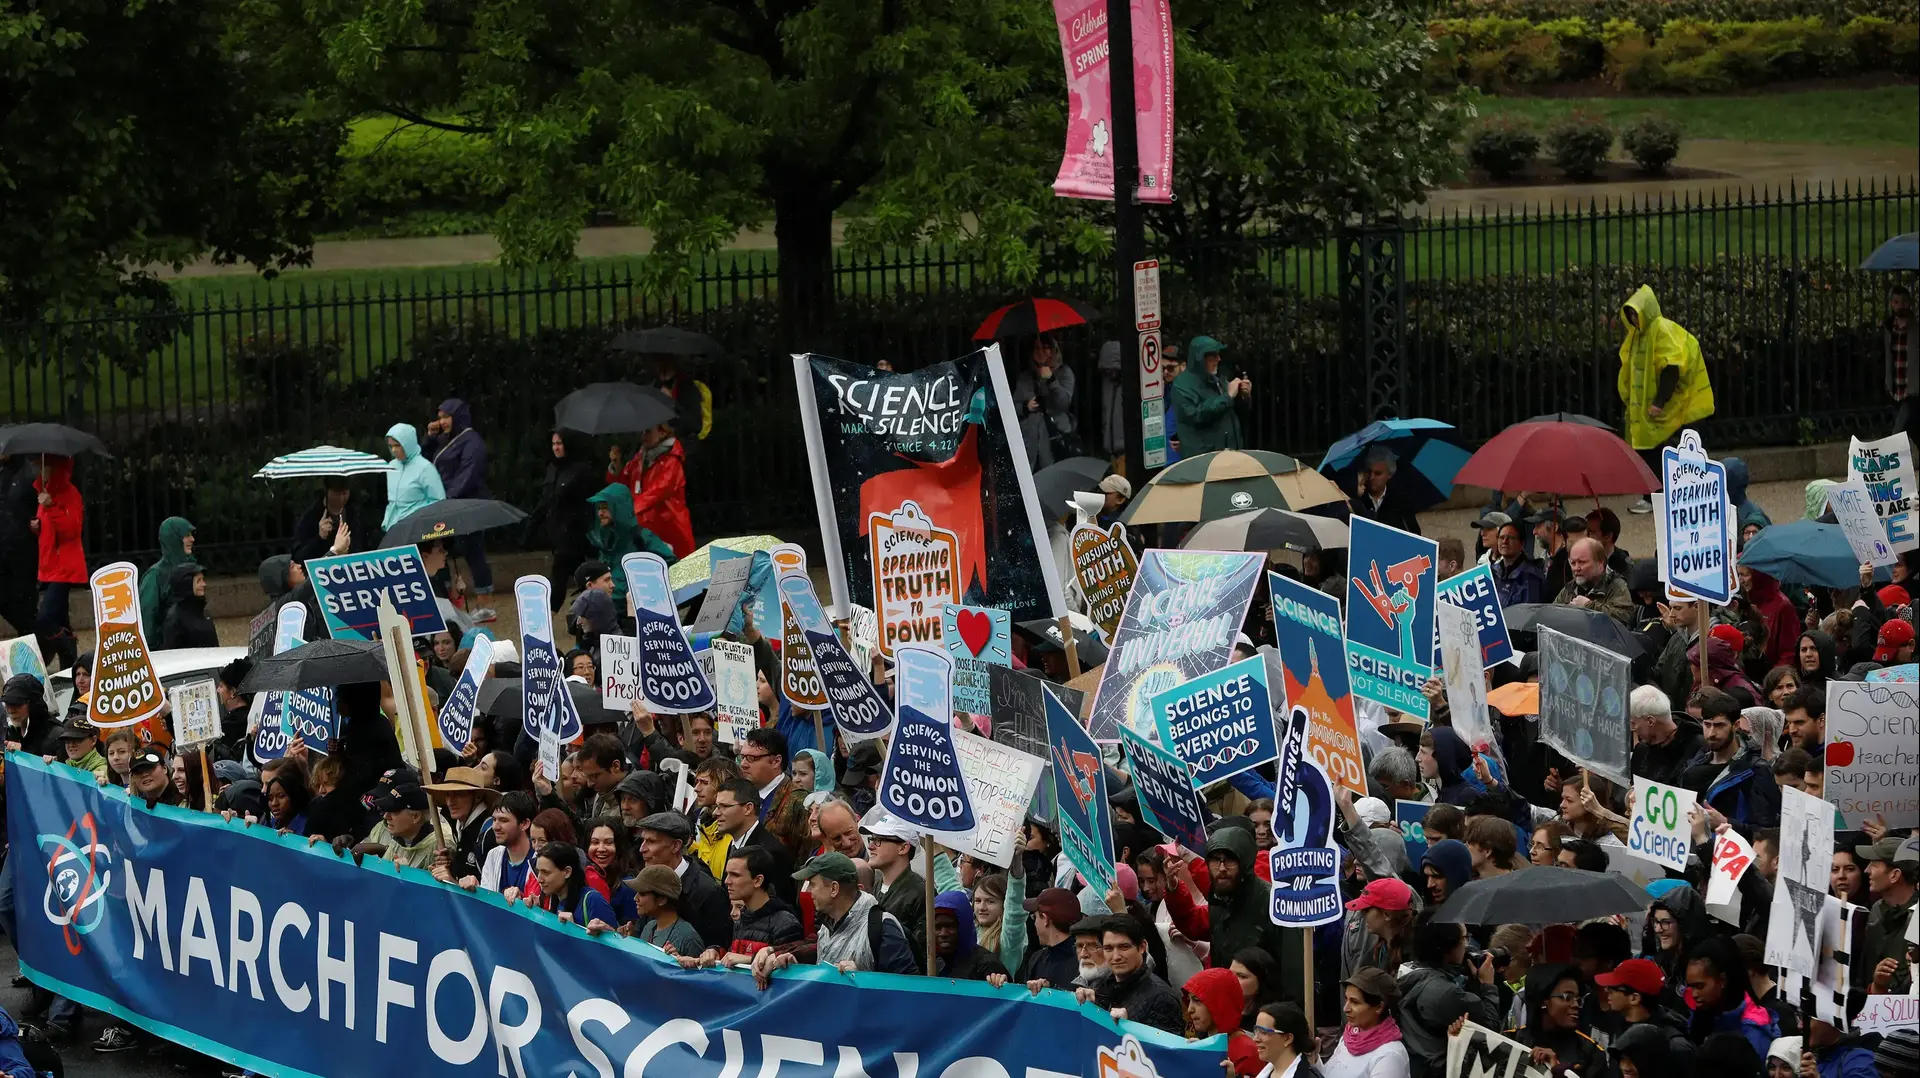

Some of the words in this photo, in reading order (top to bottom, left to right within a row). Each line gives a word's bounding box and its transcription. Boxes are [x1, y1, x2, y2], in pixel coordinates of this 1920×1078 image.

[1076, 39, 1110, 73] SPRING
[1158, 0, 1172, 192] nationalcherryblossomfestival.o
[828, 374, 960, 416] SCIENCE
[874, 409, 960, 436] SILENCE
[1859, 448, 1880, 458] THE
[1672, 464, 1708, 484] SCIENCE
[1671, 480, 1718, 504] SPEAKING
[1672, 501, 1720, 529] TRUTH
[1888, 498, 1911, 515] ARE
[884, 530, 932, 552] SCIENCE
[1075, 532, 1099, 552] SCIENCE
[1690, 532, 1700, 544] TO
[882, 548, 950, 576] SPEAKING
[1076, 537, 1118, 568] PURSUING
[1674, 548, 1721, 575] POWER
[314, 554, 418, 586] SCIENCE
[1081, 551, 1126, 588] TRUTH
[324, 582, 427, 614] SERVES
[882, 570, 951, 602] TRUTH
[1088, 584, 1114, 605] SAVING
[1115, 574, 1130, 589] THE
[910, 600, 924, 618] TO
[1138, 575, 1226, 627] SCIENCE
[1274, 594, 1342, 640] SCIENCE
[104, 632, 137, 651] SCIENCE
[642, 622, 676, 637] SCIENCE
[886, 616, 942, 646] POWE
[527, 648, 552, 664] SCIENCE
[606, 638, 630, 660] Only
[644, 640, 684, 652] SERVING
[730, 643, 741, 653] LOST
[742, 646, 752, 656] OUR
[796, 647, 807, 655] THE
[815, 643, 840, 658] SCIENCE
[1118, 612, 1234, 676] UNIVERSAL
[102, 648, 142, 668] SERVING
[114, 662, 128, 673] THE
[645, 660, 695, 677] COMMON
[657, 652, 671, 661] THE
[724, 652, 745, 663] PATIENCE
[787, 657, 816, 672] COMMO
[821, 661, 852, 675] SERVING
[98, 666, 150, 693] COMMON
[834, 675, 846, 683] THE
[1350, 652, 1428, 690] SCIENCE
[536, 681, 547, 690] THE
[647, 676, 702, 700] GOOD
[788, 673, 820, 696] GOO
[830, 680, 868, 701] COMMON
[1350, 676, 1372, 690] NOT
[1376, 683, 1428, 712] SILENCE
[97, 681, 154, 714] GOOD
[288, 692, 331, 722] EVERYONE
[456, 690, 472, 712] SERVING
[528, 692, 549, 706] COMM
[1165, 674, 1251, 721] SCIENCE
[263, 714, 281, 728] COMM
[448, 702, 470, 728] COMMON
[719, 704, 727, 712] THE
[729, 706, 748, 716] OCEANS
[719, 714, 734, 723] RISING
[836, 697, 880, 725] GOOD
[1169, 705, 1230, 740] BELONGS
[1233, 697, 1252, 714] TO
[443, 713, 467, 743] GOOD
[902, 724, 946, 746] SCIENCE
[1174, 715, 1256, 760] EVERYONE
[1308, 720, 1356, 756] OMMON
[1598, 717, 1622, 740] HAVE
[899, 744, 951, 766] SERVING
[913, 759, 931, 772] THE
[1124, 733, 1190, 790] SCIENCE
[1312, 744, 1360, 785] OOD
[893, 767, 958, 792] COMMON
[1281, 731, 1302, 814] SCIENCE
[889, 784, 964, 820] GOOD
[970, 778, 999, 801] STOP
[1000, 788, 1030, 805] CLIMATE
[1133, 766, 1197, 823] SERVES
[1646, 786, 1677, 831] GO
[992, 811, 1020, 832] RISIN
[975, 829, 1003, 854] WE
[1064, 838, 1080, 864] NOT
[1630, 815, 1686, 864] Science
[1062, 818, 1113, 889] SCIENCE
[1275, 851, 1333, 873] PROTECTING
[1292, 875, 1312, 891] OUR
[1275, 893, 1336, 917] COMMUNITIES
[124, 859, 356, 1030] MARCH
[376, 931, 543, 1078] FOR
[1870, 1004, 1878, 1025] of
